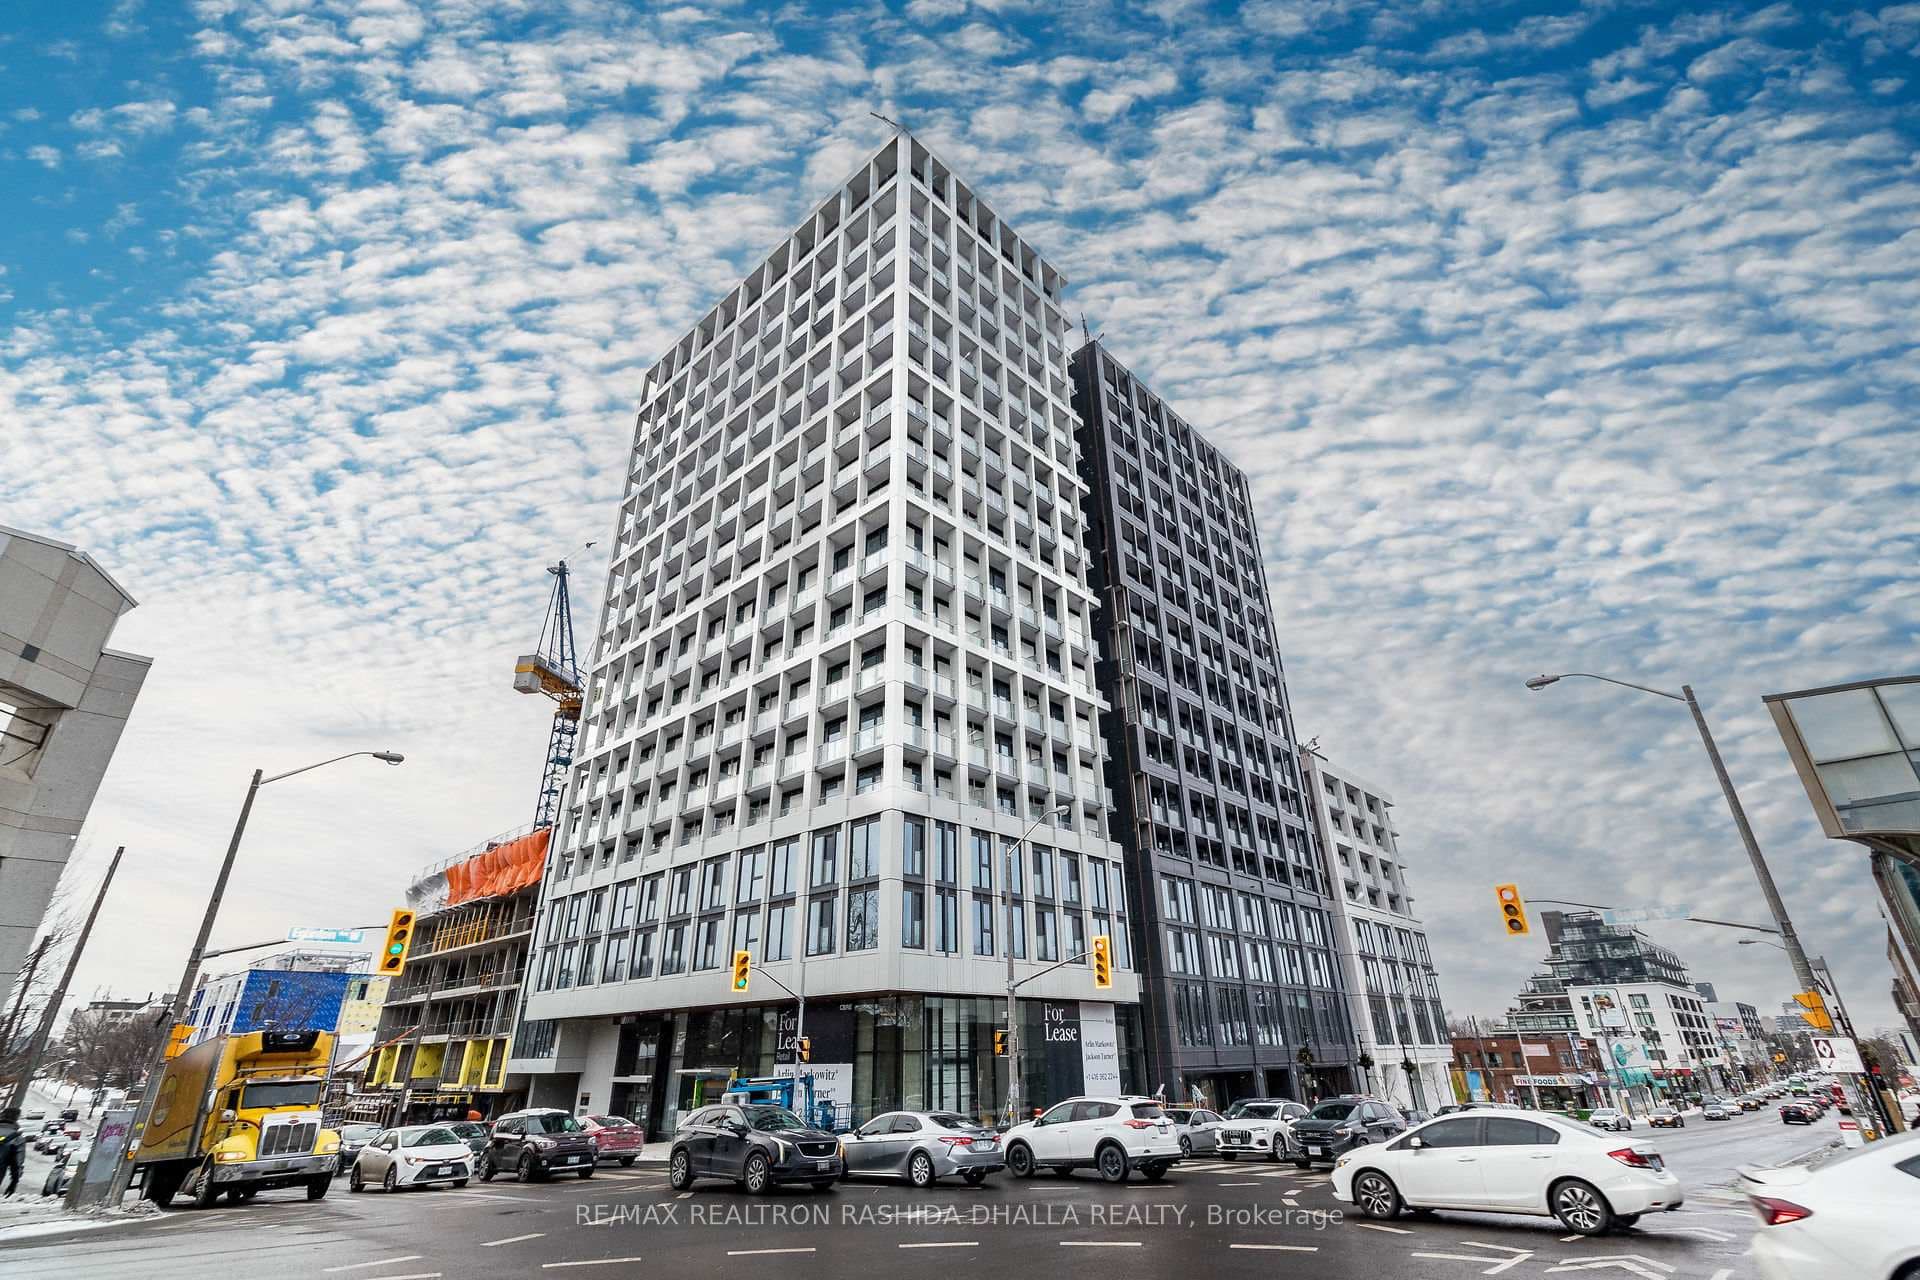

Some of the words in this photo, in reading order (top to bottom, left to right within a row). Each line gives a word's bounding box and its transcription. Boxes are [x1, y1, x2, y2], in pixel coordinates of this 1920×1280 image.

[1044, 1003, 1064, 1021] For
[780, 1012, 797, 1031] For
[1045, 1022, 1078, 1041] Lease
[777, 1032, 797, 1050] Lea
